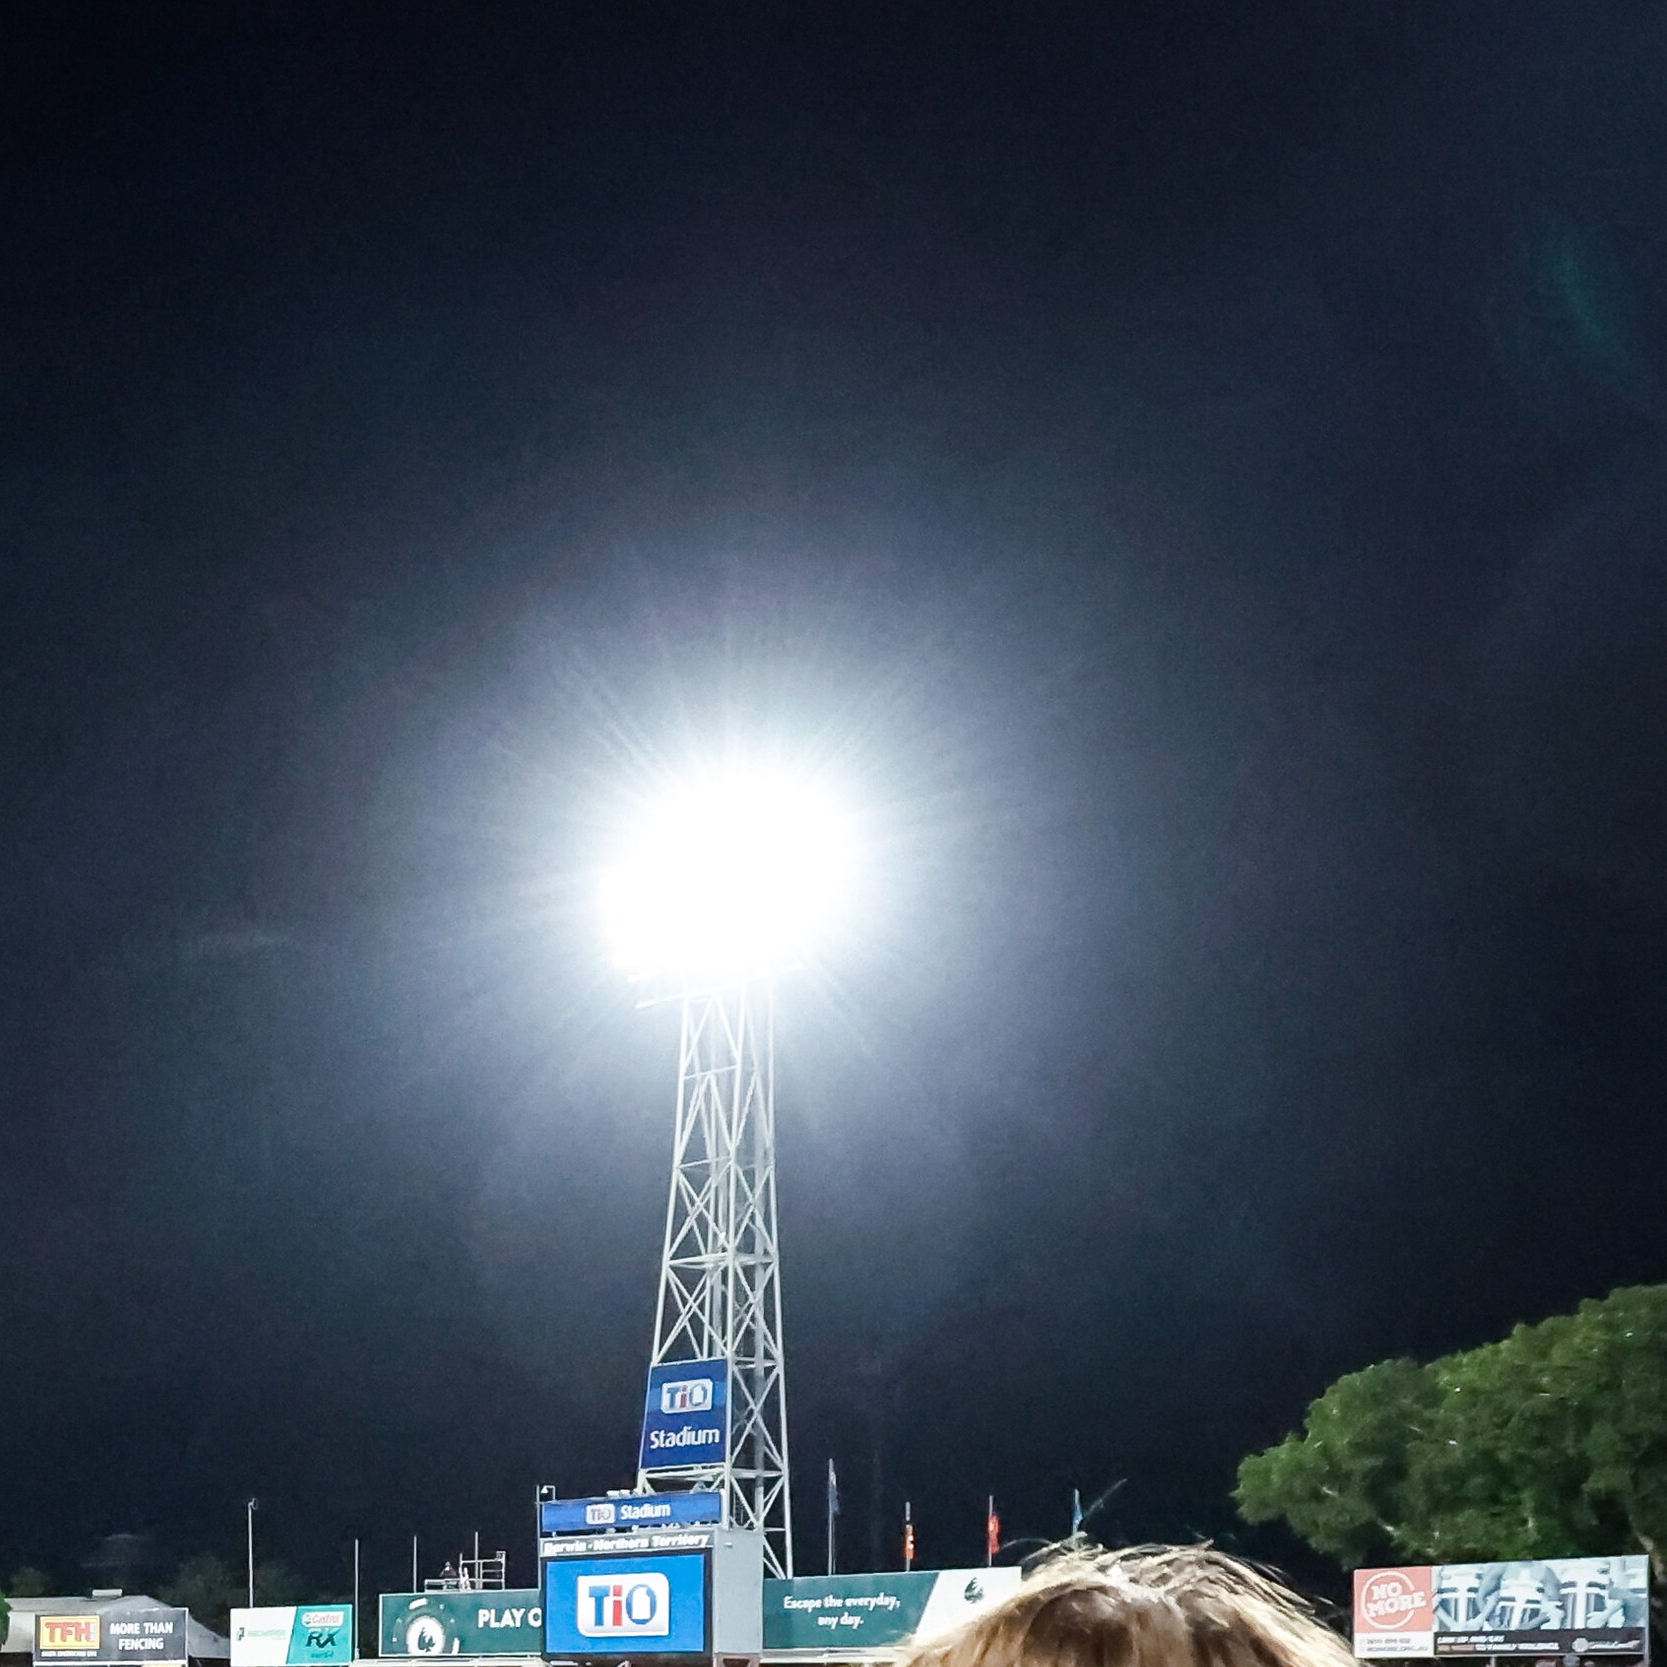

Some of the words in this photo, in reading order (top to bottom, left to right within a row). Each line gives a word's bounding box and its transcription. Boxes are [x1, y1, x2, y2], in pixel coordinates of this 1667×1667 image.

[649, 1425, 721, 1449] Stadium
[620, 1503, 672, 1520] Stadium
[544, 1541, 587, 1555] Darwin
[593, 1537, 649, 1551] Northern
[652, 1534, 710, 1548] Territory
[1370, 1581, 1403, 1601] NO
[783, 1595, 822, 1613] Escape
[823, 1594, 843, 1608] the
[845, 1592, 901, 1611] everyday,
[1366, 1591, 1428, 1618] MORE
[477, 1607, 526, 1629] PLAY
[817, 1615, 839, 1630] any
[839, 1611, 864, 1630] day.
[45, 1621, 90, 1643] TFH
[110, 1622, 141, 1635] MORE
[143, 1621, 174, 1635] THAN
[118, 1637, 165, 1651] FENCING
